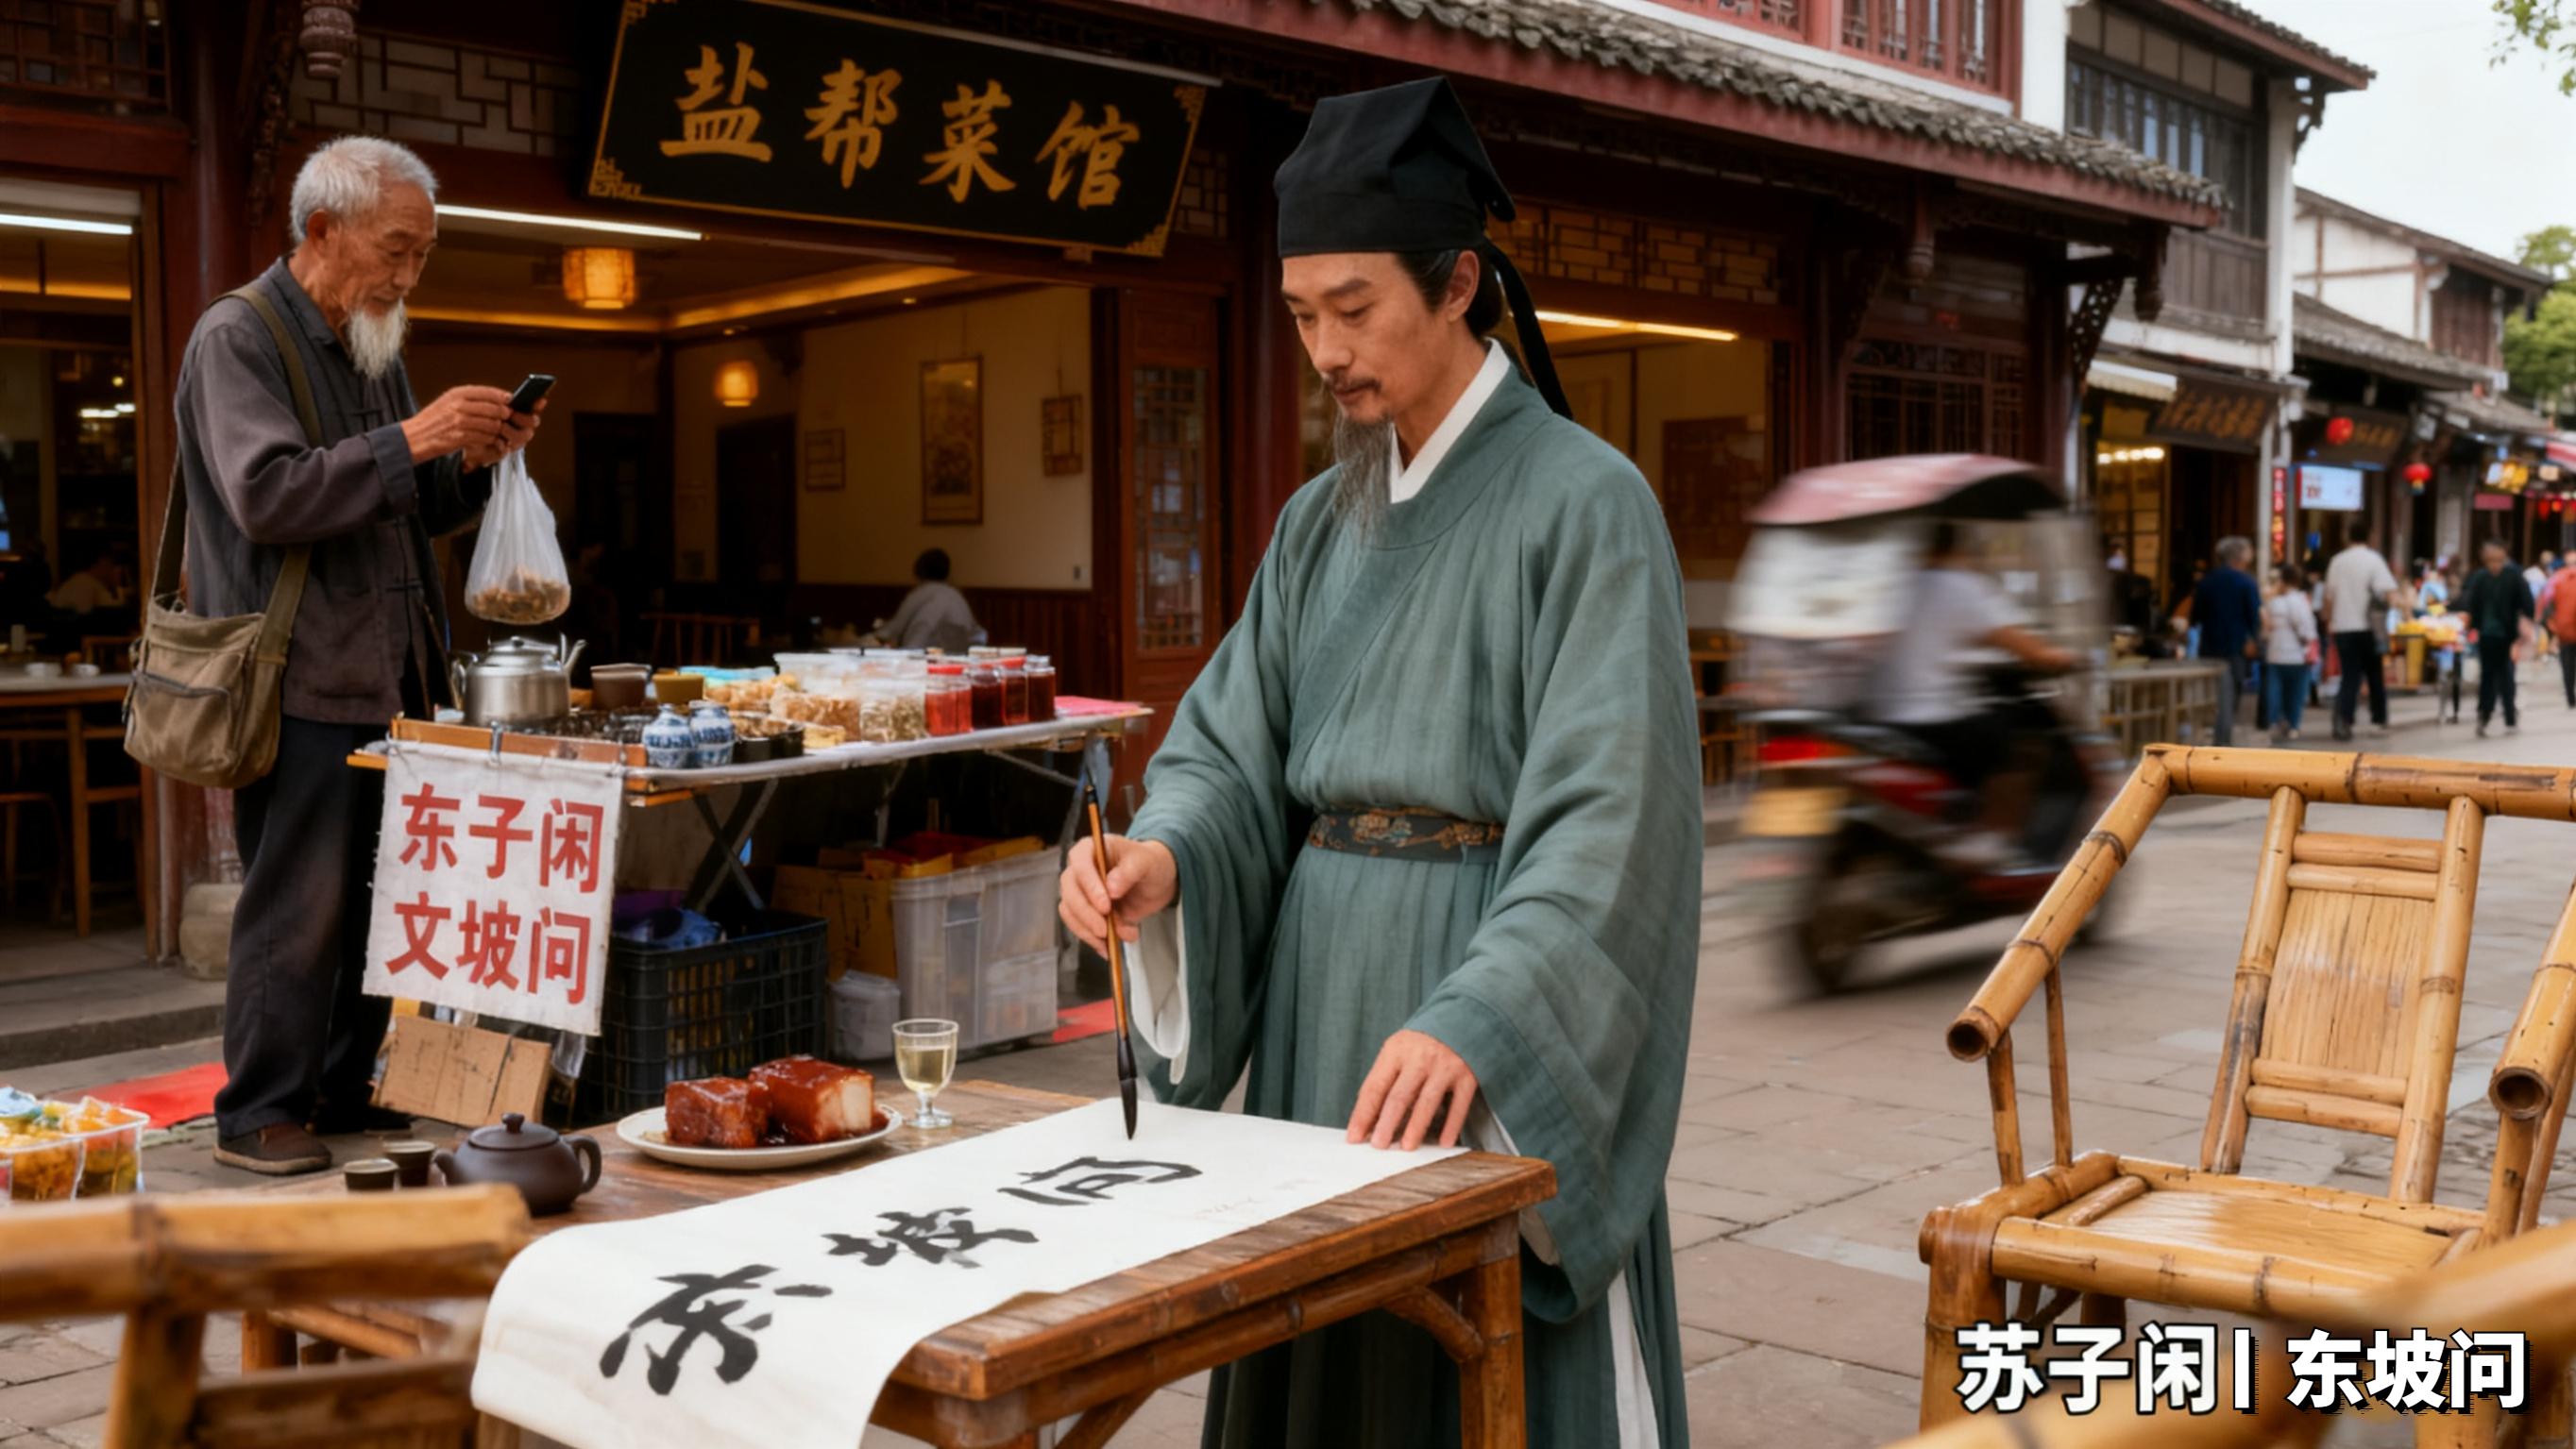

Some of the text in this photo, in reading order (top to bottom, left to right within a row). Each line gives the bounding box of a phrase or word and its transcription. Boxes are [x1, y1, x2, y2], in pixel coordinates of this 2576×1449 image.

[660, 42, 1141, 210] 盐帮菜馆
[398, 783, 604, 893] 东子闲
[384, 891, 592, 1004] 文坡问
